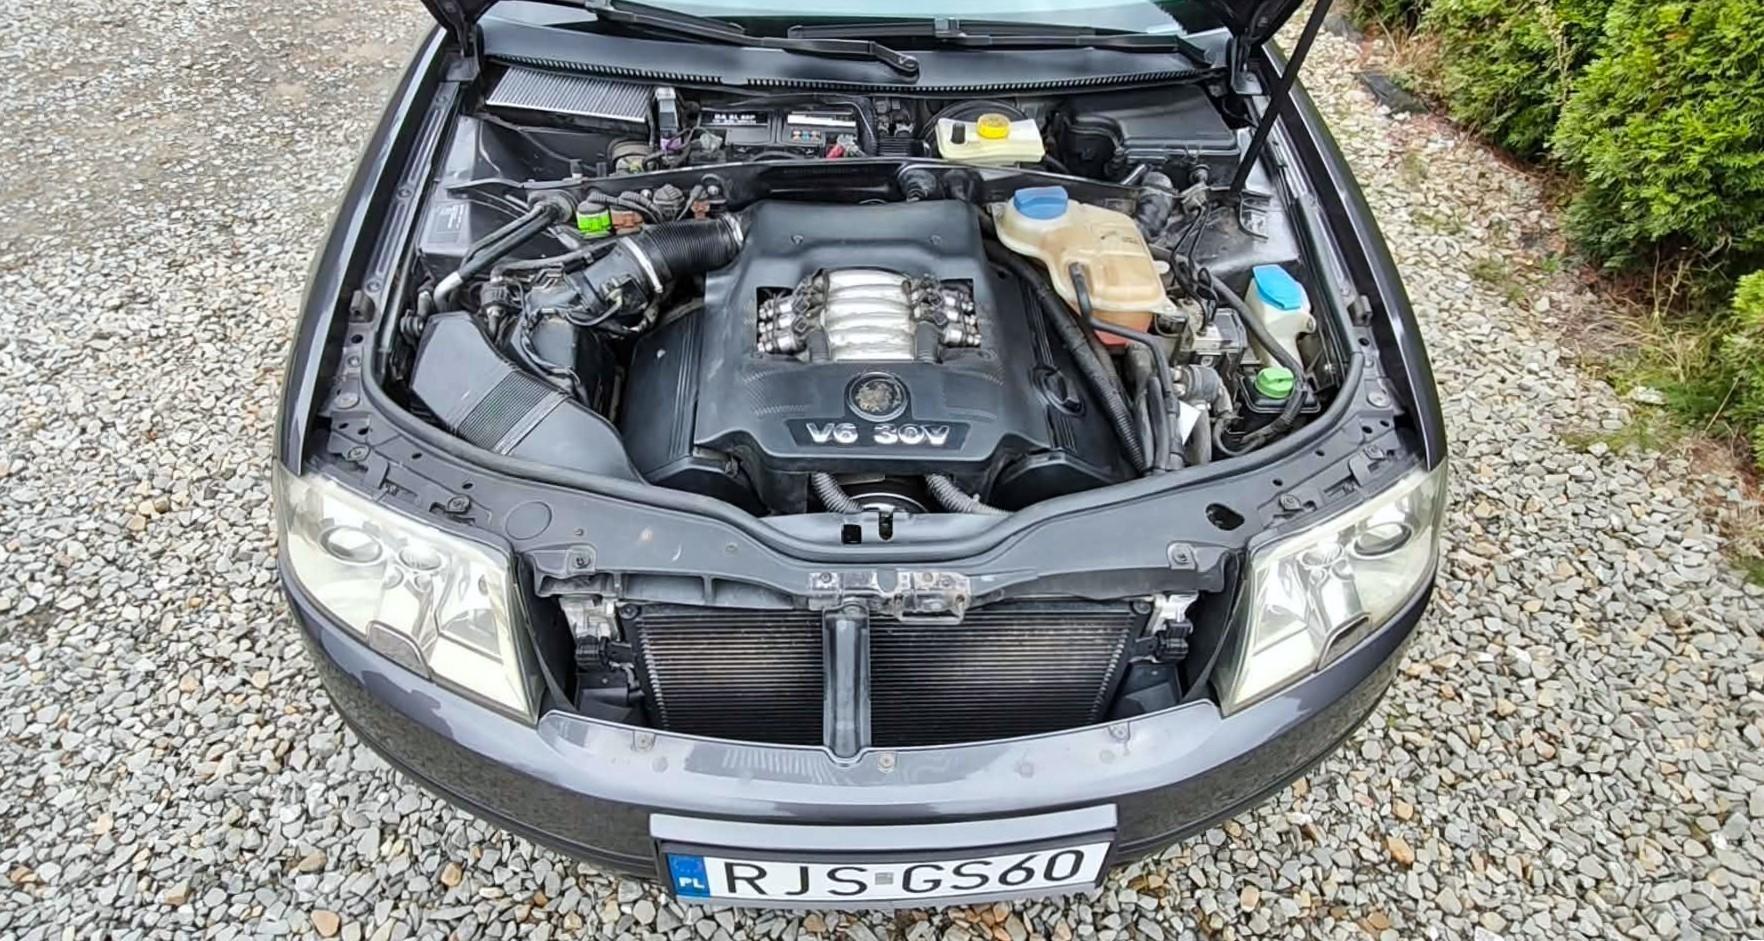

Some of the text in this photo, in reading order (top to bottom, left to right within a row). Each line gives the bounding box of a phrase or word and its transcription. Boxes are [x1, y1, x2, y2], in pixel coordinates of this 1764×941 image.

[806, 422, 950, 446] V6 30V
[679, 877, 705, 889] PL
[724, 849, 1085, 896] RJS GS60
